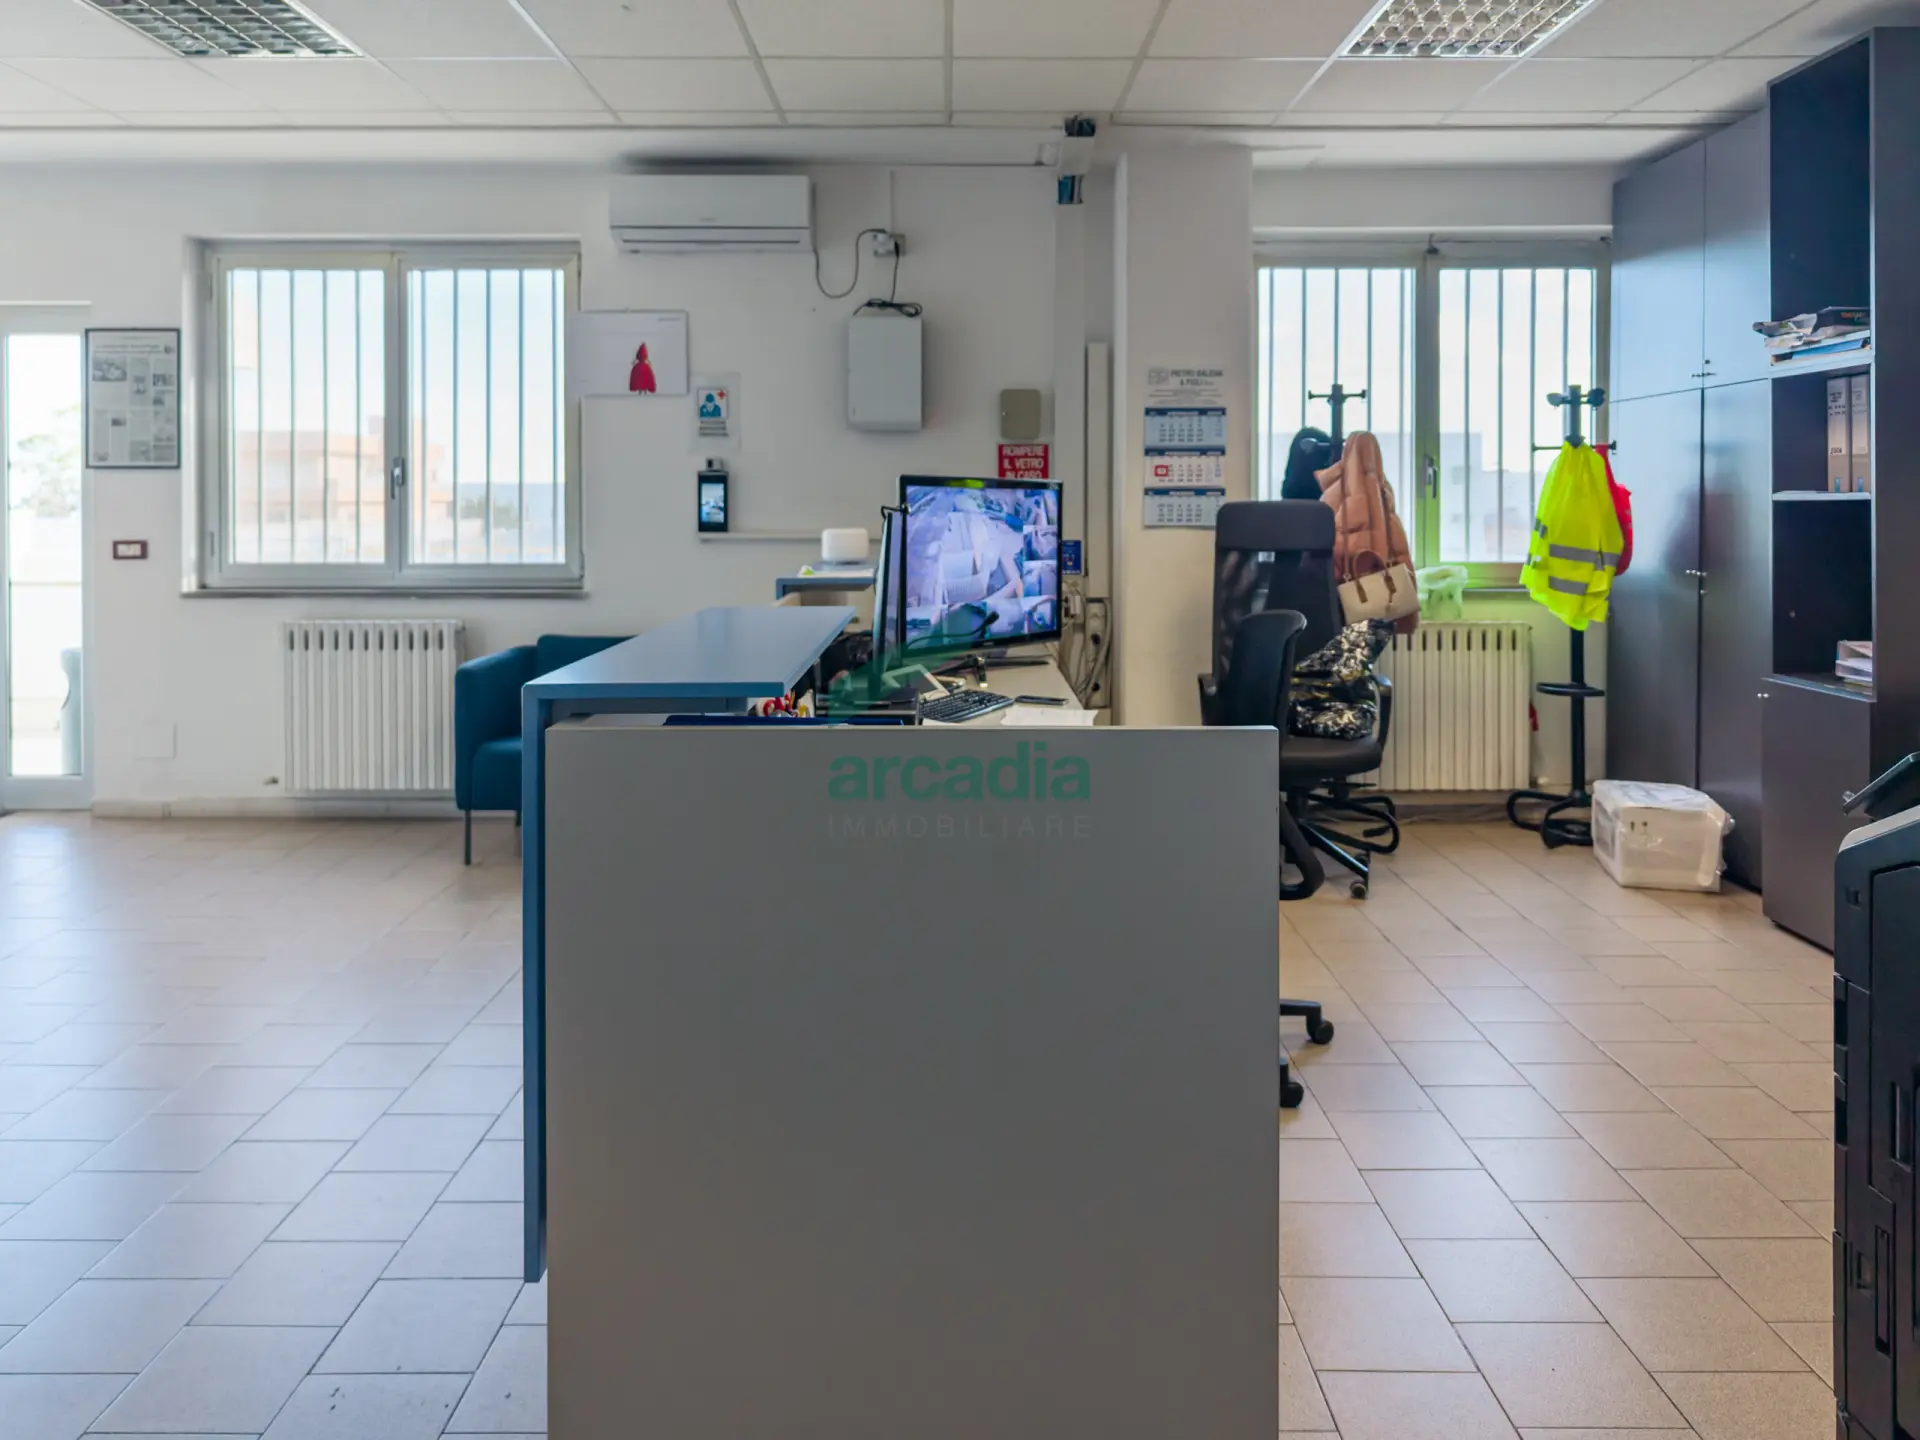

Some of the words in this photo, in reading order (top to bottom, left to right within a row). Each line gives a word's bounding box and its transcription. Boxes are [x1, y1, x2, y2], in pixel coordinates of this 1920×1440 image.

[1002, 445, 1045, 457] ROMPERE
[1002, 458, 1013, 469] IL
[1014, 458, 1045, 469] VETRO
